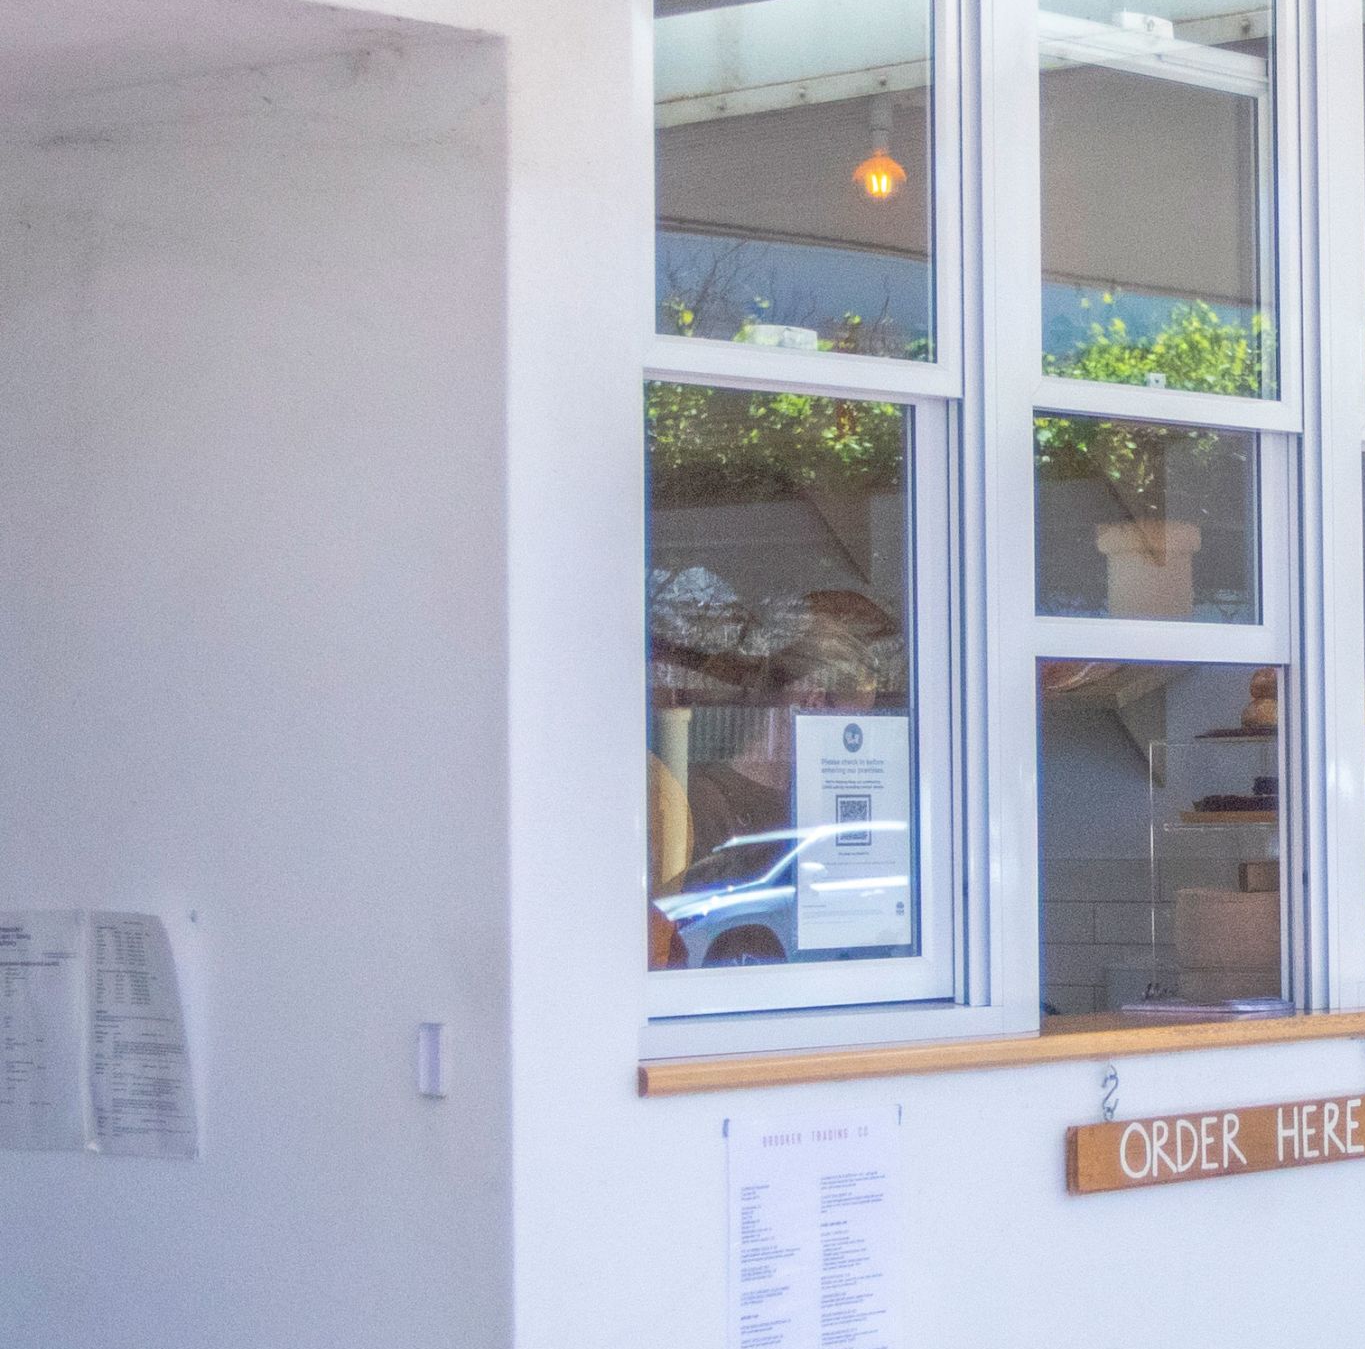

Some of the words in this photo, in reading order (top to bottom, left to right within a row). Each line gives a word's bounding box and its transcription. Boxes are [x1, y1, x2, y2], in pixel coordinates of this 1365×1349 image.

[762, 1133, 802, 1148] BROOKER
[811, 1128, 849, 1142] TRADING
[1119, 1113, 1248, 1179] ORDER
[1276, 1098, 1365, 1162] HERE
